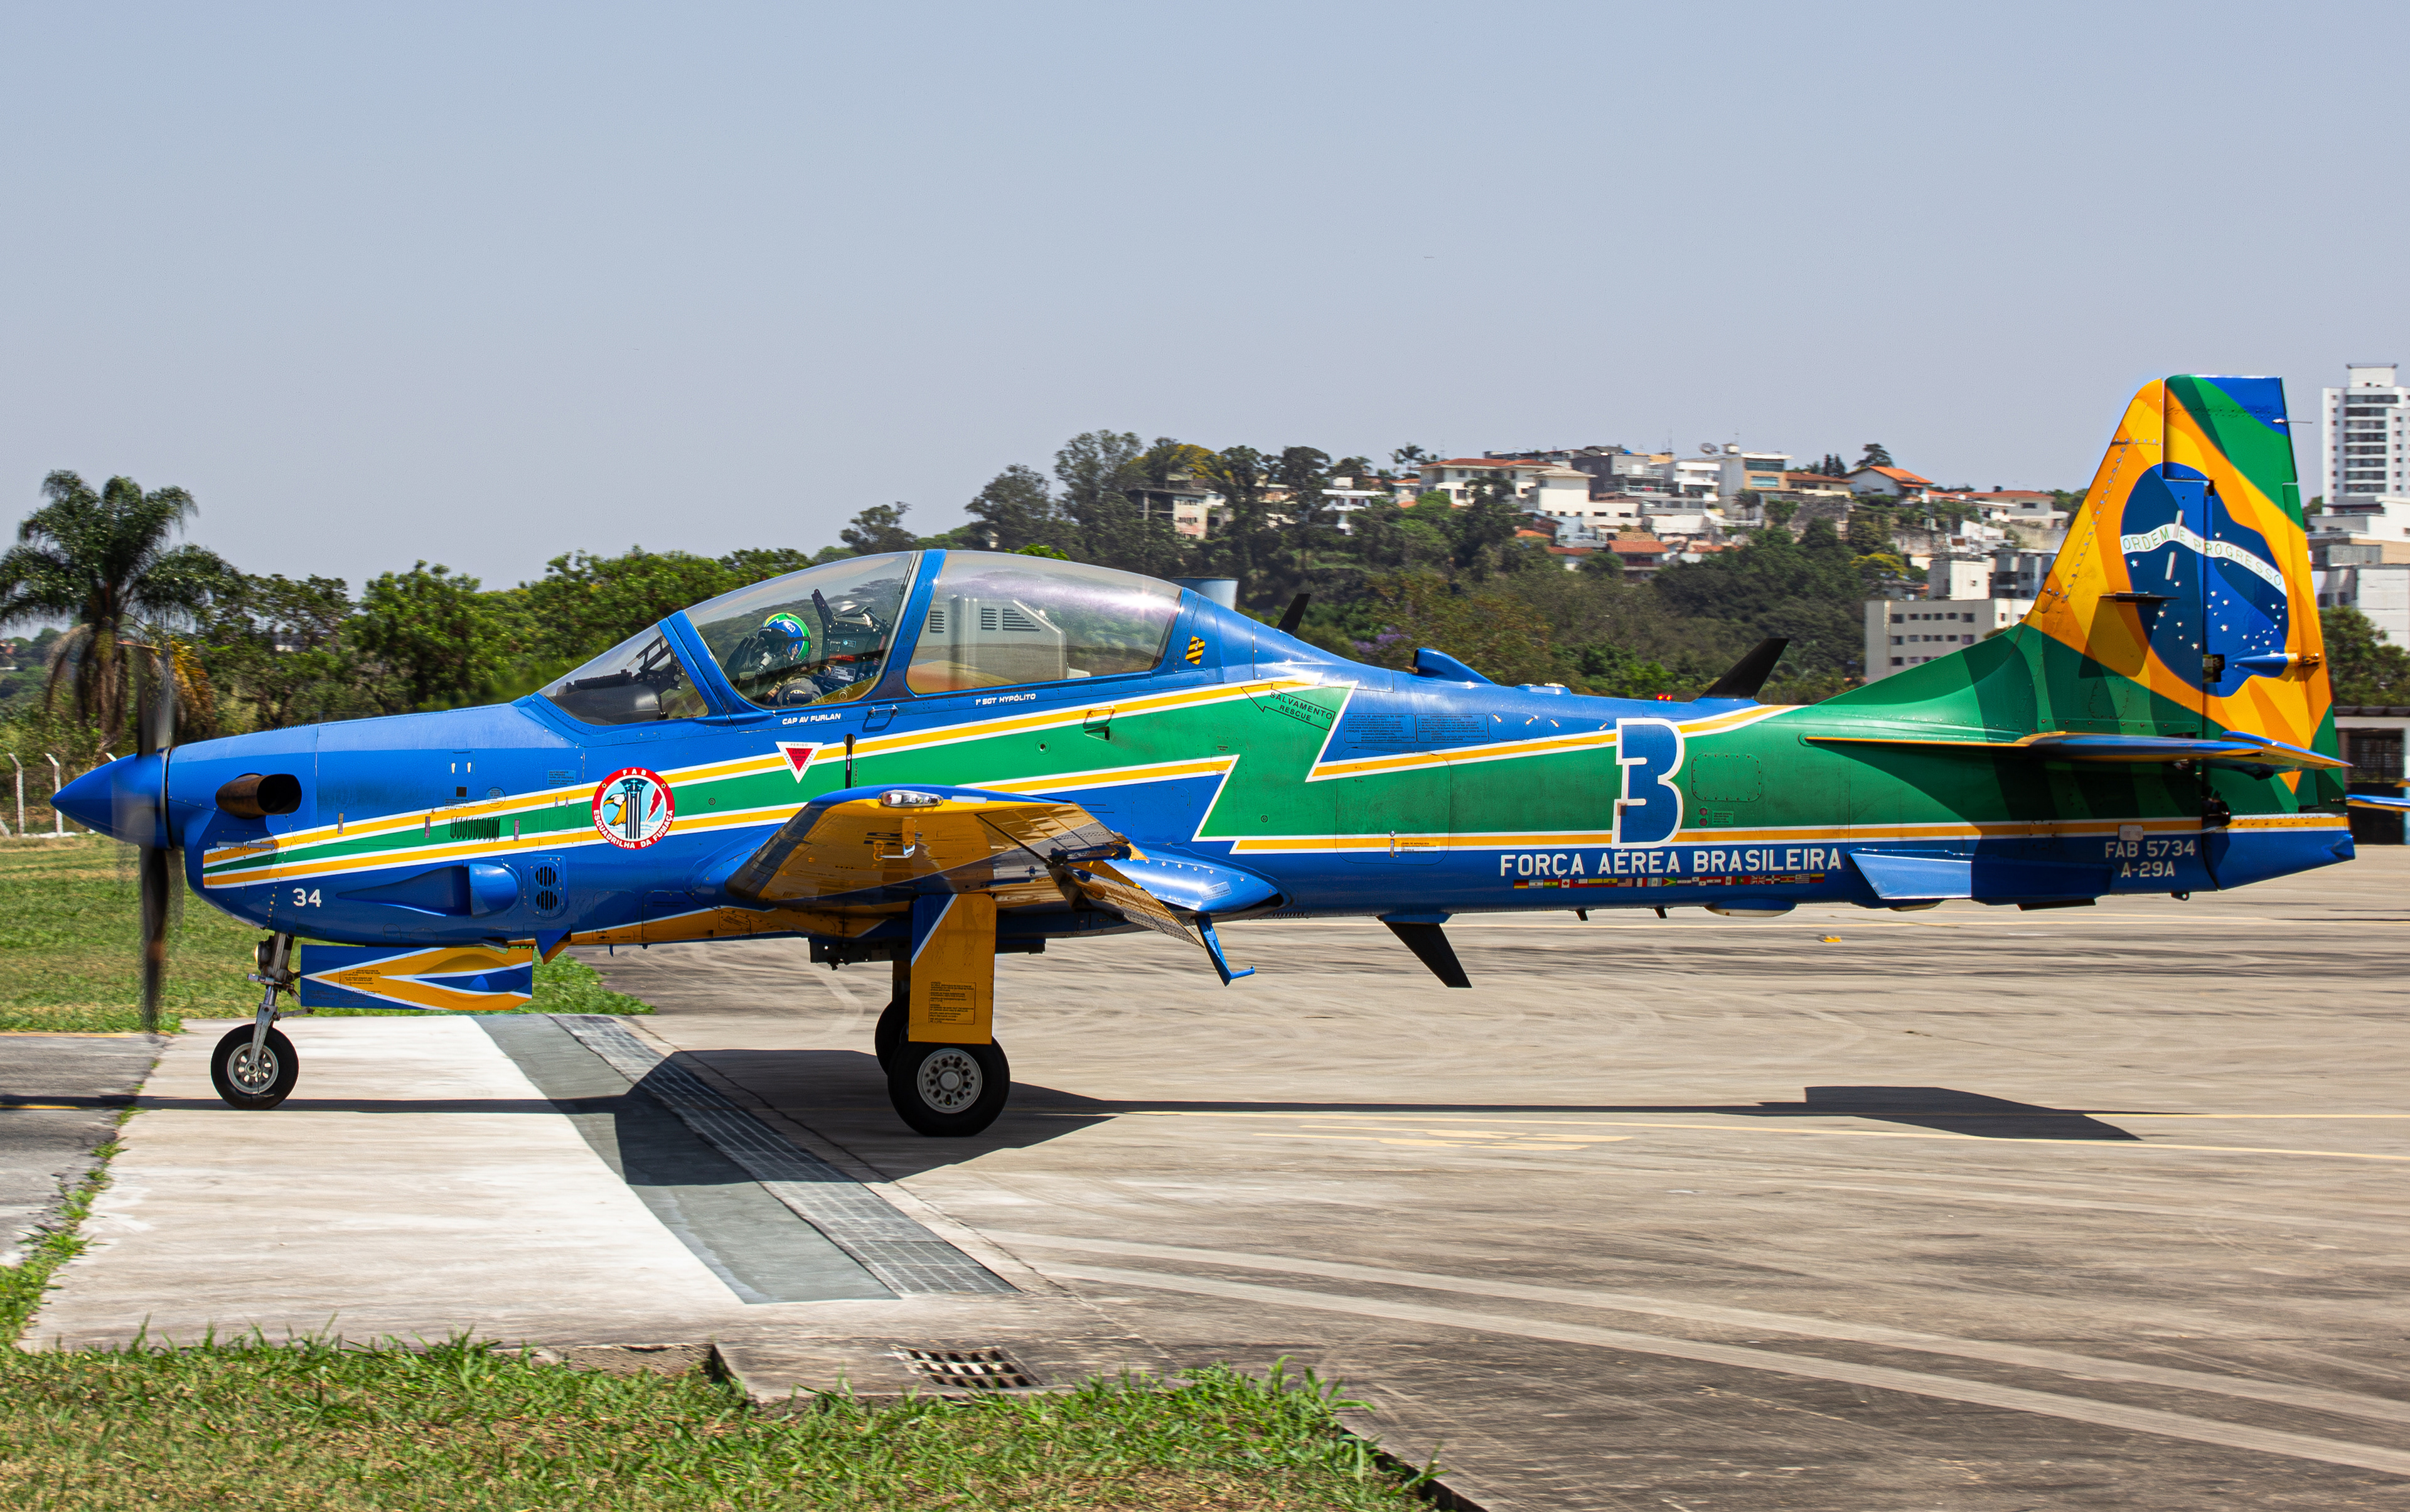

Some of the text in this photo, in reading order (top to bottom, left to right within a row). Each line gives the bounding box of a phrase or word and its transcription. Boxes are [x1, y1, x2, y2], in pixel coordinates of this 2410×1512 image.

[2123, 527, 2282, 586] ORDEM E PROGRESSO
[982, 697, 997, 705] SGT
[1270, 692, 1332, 720] SALVAMENTO
[782, 712, 842, 725] CAP AV FURLAN
[1279, 704, 1312, 721] RESCUE
[784, 753, 795, 769] DANGER
[802, 753, 814, 770] DANGER
[594, 809, 636, 849] ESQUADRILHA
[653, 810, 673, 841] FUMAÇA
[2105, 840, 2196, 858] FAB 5734
[1500, 847, 1843, 879] FORÇA AÉREA BRASILEIRA
[2121, 861, 2176, 877] A-29A
[293, 887, 322, 907] 34
